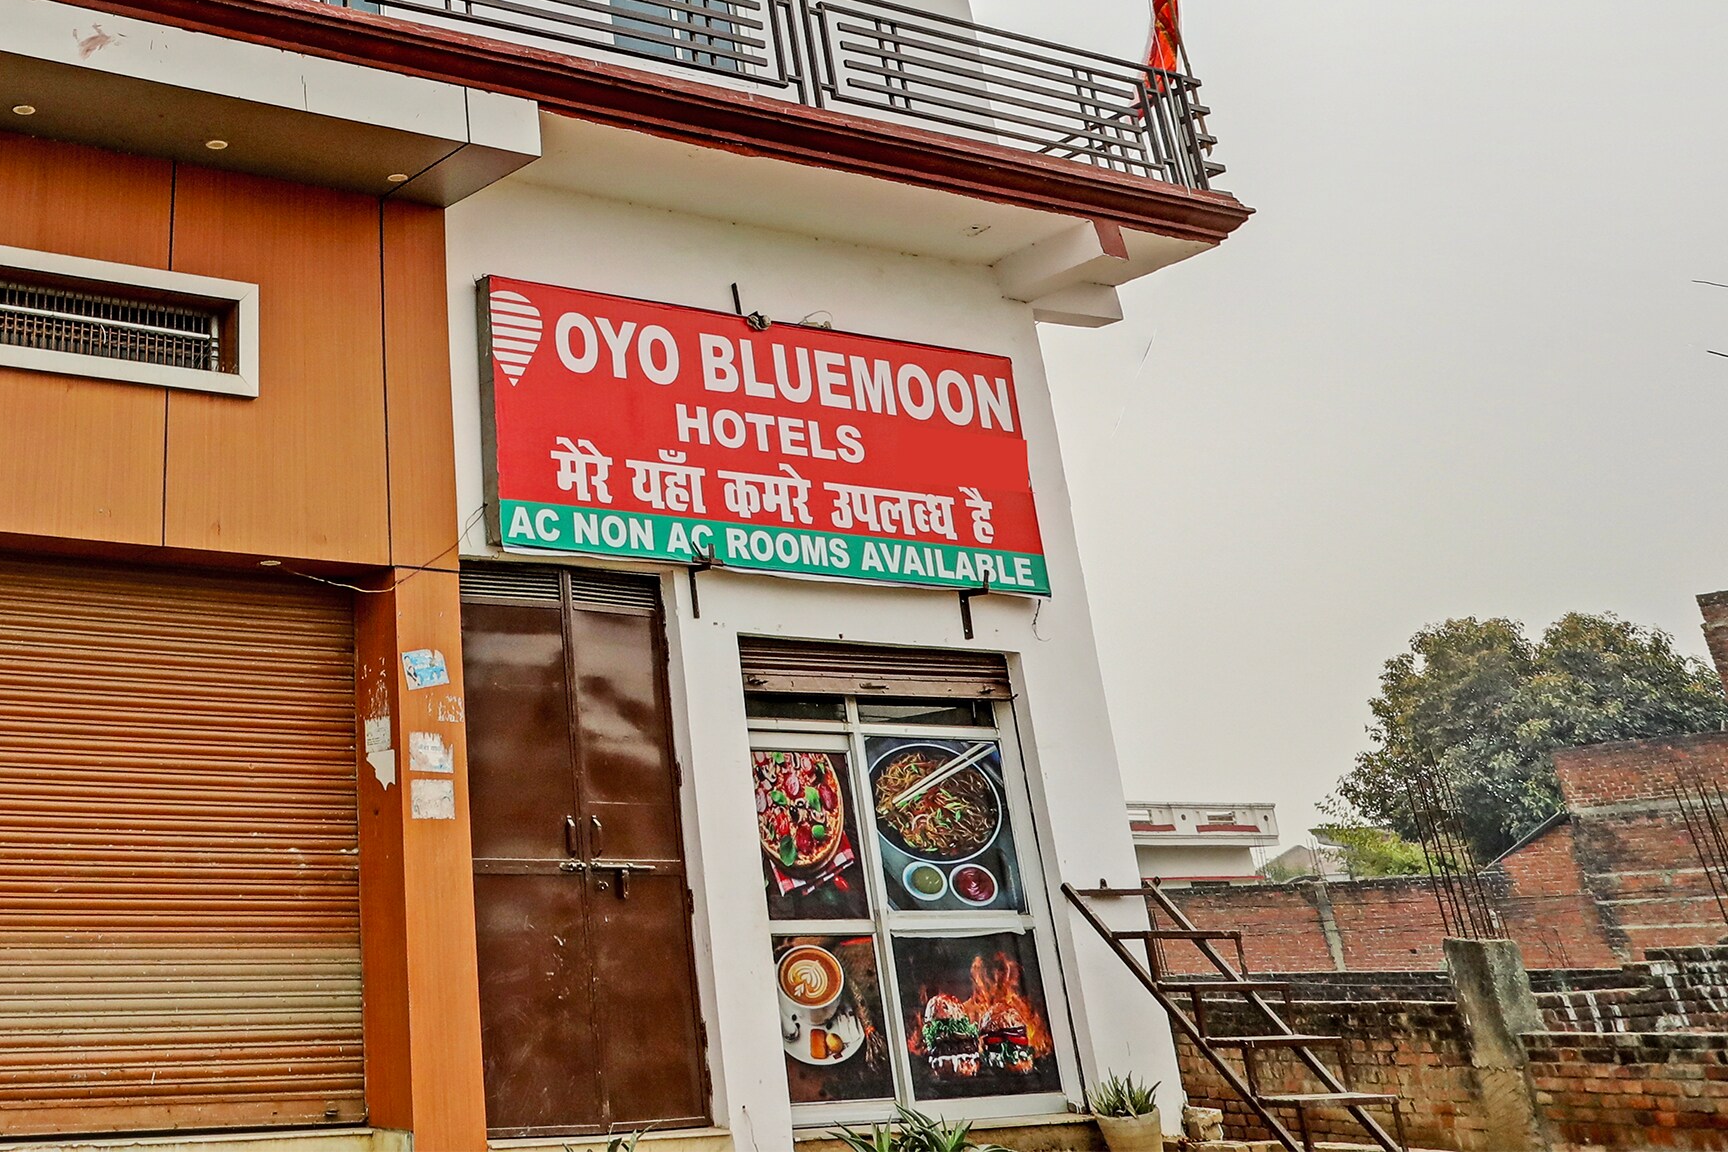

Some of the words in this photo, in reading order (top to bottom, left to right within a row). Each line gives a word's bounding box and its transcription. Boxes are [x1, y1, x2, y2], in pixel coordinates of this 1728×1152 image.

[554, 310, 681, 387] OYO
[698, 332, 1016, 434] BLUEMOON
[674, 402, 867, 465] HOTELS
[549, 435, 614, 505] मेरे
[624, 449, 708, 515] यहाँ
[716, 462, 814, 527] कमरे
[822, 480, 956, 543] उपलब्ध
[957, 484, 995, 546] है
[507, 504, 562, 543] AC
[573, 511, 656, 552] NON
[666, 520, 715, 558] AC
[725, 525, 852, 571] ROOMS
[859, 539, 1036, 589] AVAILABLE
